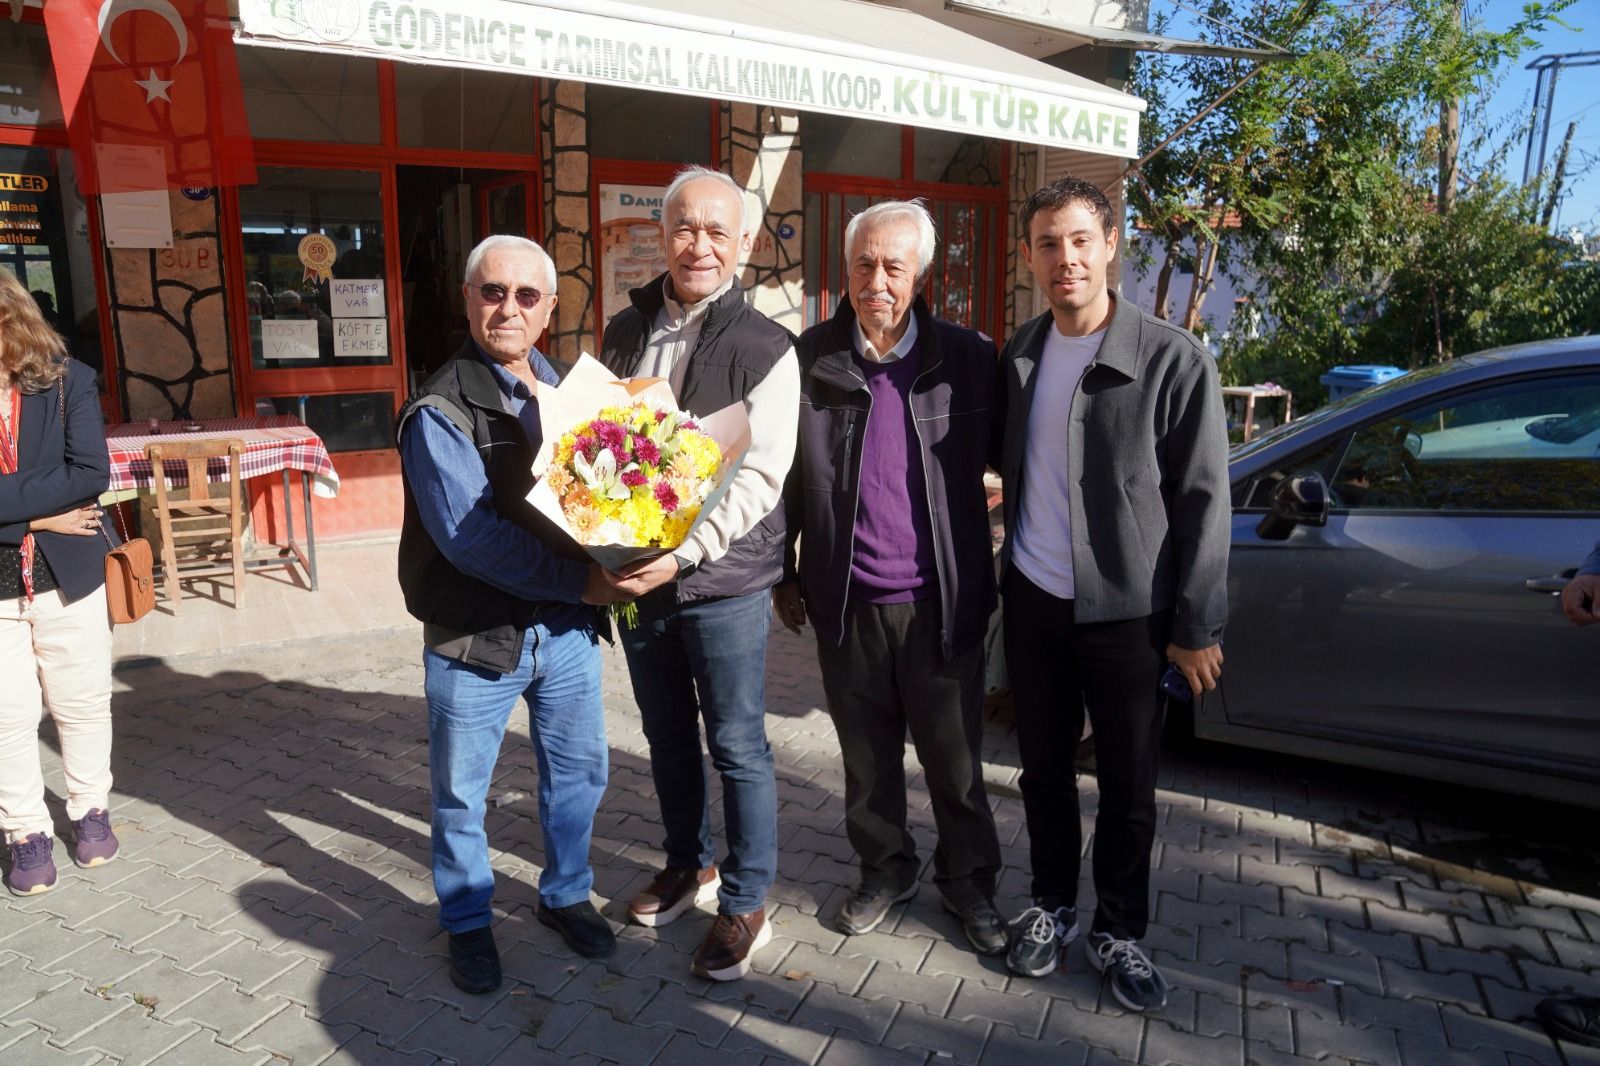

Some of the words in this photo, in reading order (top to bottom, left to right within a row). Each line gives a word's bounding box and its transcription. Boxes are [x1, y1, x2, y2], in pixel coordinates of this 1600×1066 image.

[535, 29, 680, 86] TARIMSAL
[687, 50, 816, 104] KALKINMA
[822, 70, 887, 113] KOOP.
[893, 71, 1040, 135] KÜLTÜR
[1049, 103, 1129, 148] KAFE
[311, 246, 324, 254] 50
[334, 283, 379, 295] KATMER
[263, 324, 307, 337] TOST
[342, 339, 385, 352] EKMEK
